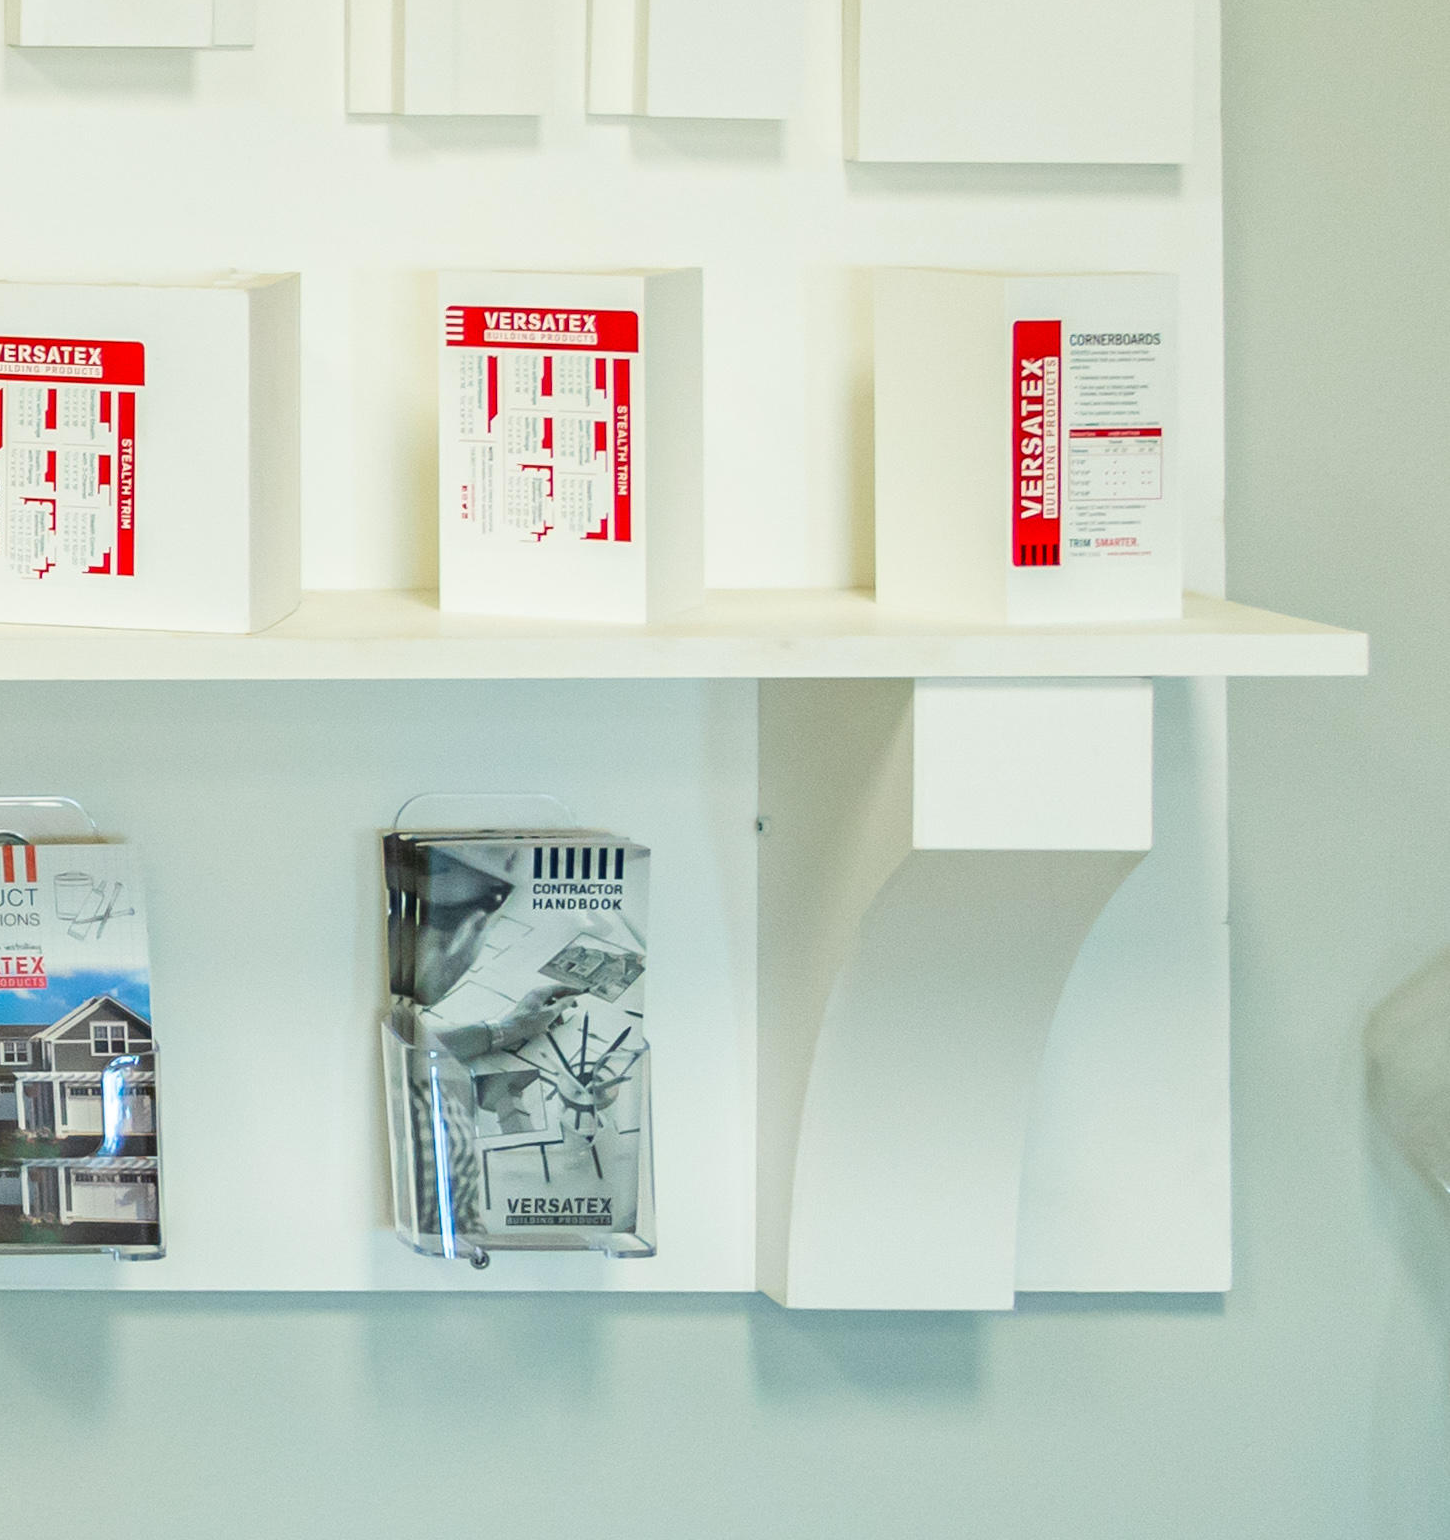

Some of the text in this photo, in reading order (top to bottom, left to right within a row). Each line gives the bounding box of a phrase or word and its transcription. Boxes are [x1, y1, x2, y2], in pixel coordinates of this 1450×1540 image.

[484, 311, 596, 332] VERSATEX
[485, 332, 595, 343] BUILDING PRODUCTS
[1070, 333, 1161, 346] CORNERBOARDS
[45, 367, 100, 376] PRODUCTS
[1021, 360, 1043, 519] VERSATEX
[1046, 360, 1056, 516] BUILDING PRODUCTS
[617, 405, 628, 496] STEALTH TRIM
[120, 438, 132, 530] STEALTH TRIM
[1069, 537, 1139, 548] TRIM SMARTER.
[533, 884, 623, 894] CONTRACTOR
[533, 899, 622, 910] HANDBOOK
[507, 1198, 612, 1213] VERSATEX
